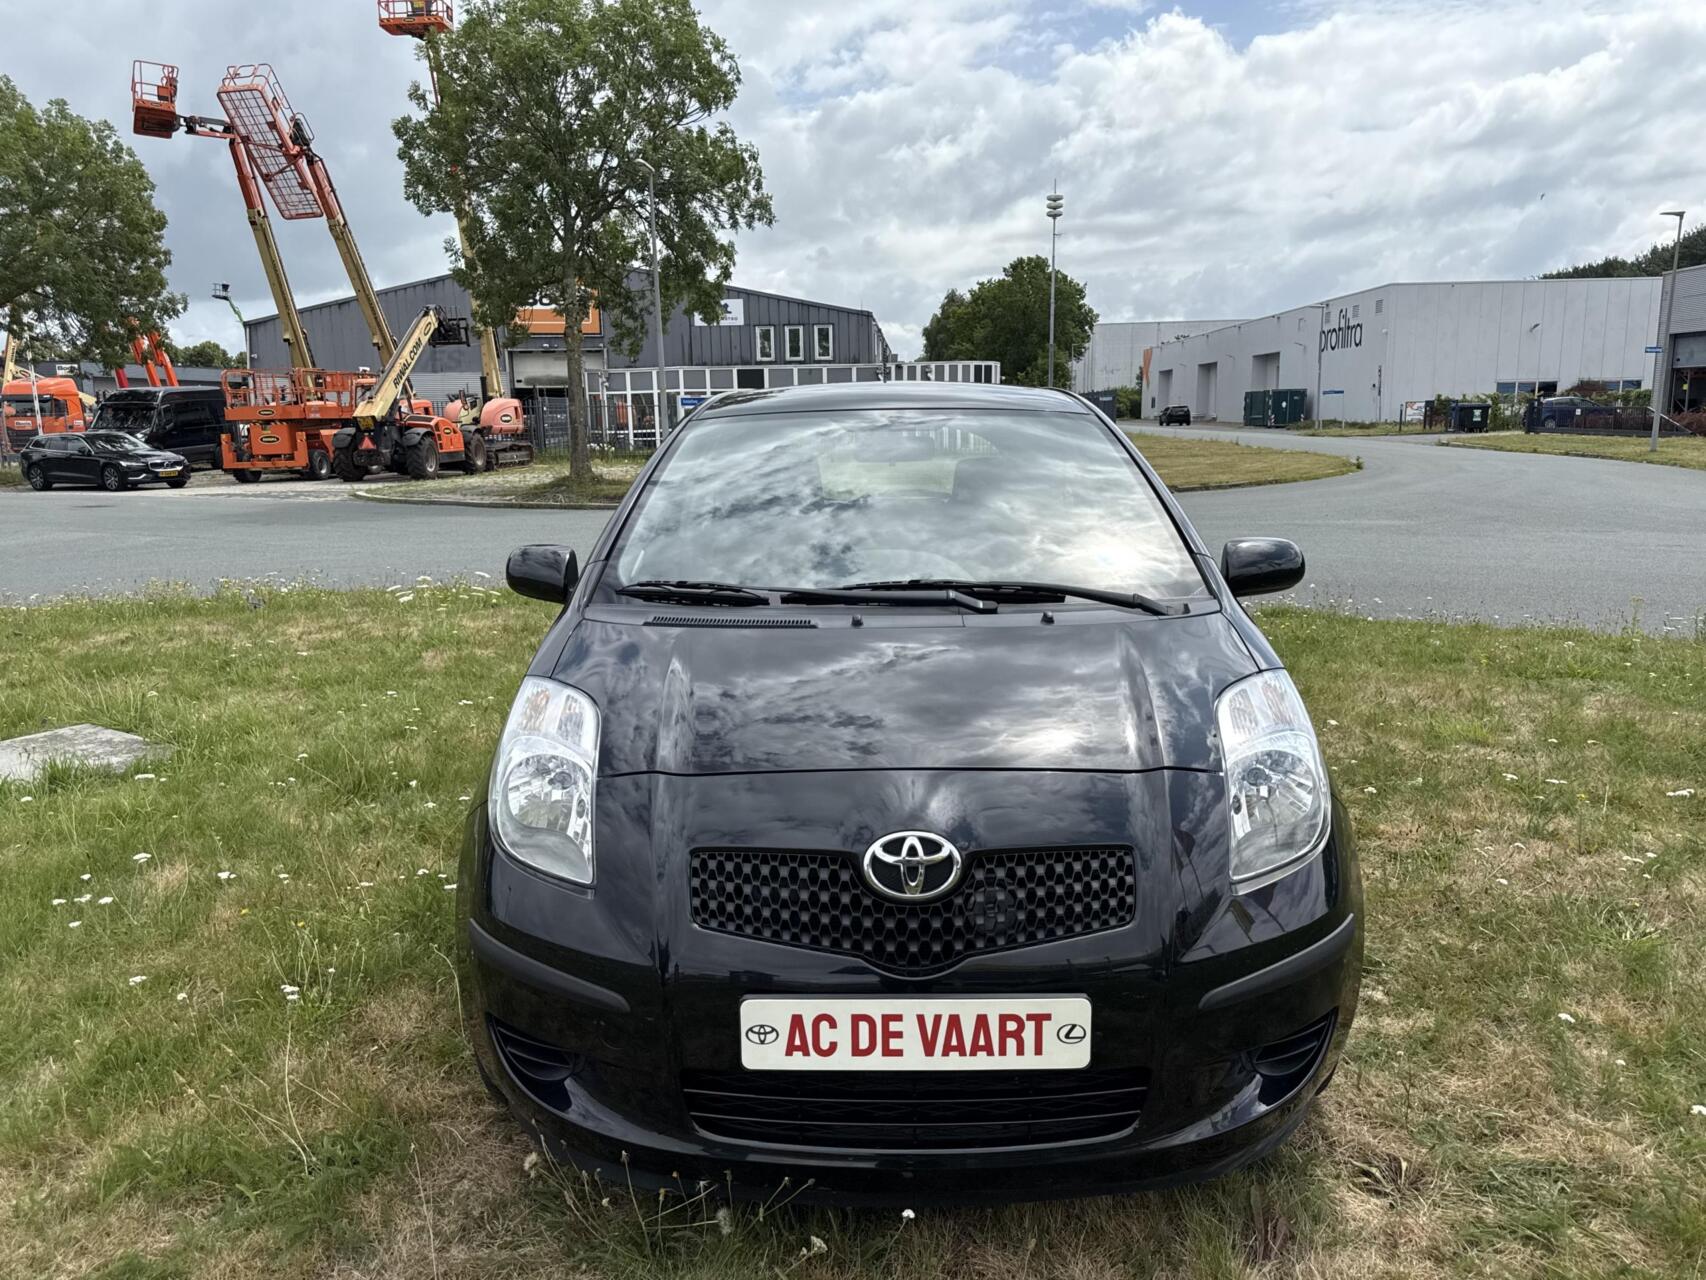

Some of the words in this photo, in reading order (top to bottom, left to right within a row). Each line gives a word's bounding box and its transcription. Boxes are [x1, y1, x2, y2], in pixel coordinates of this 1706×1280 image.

[1320, 307, 1363, 353] profiltra
[784, 1012, 838, 1058] AC
[850, 1013, 904, 1057] DE
[915, 1012, 1053, 1057] VAART
